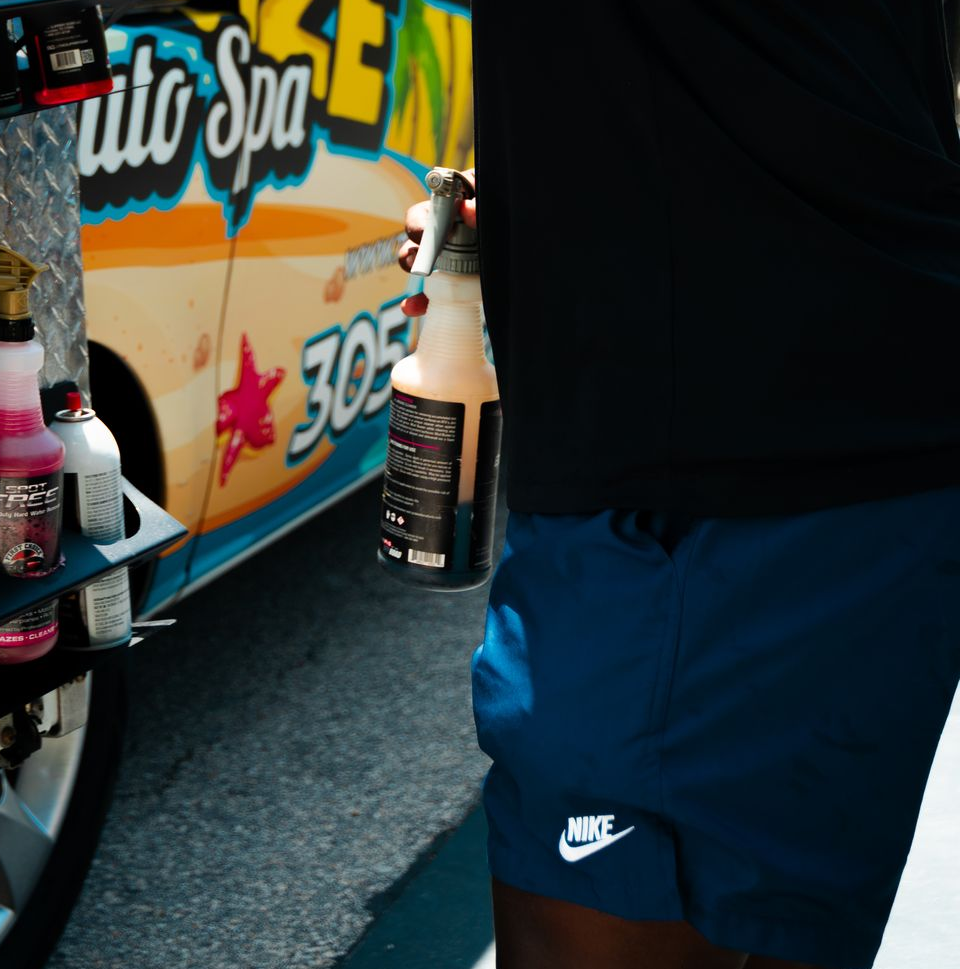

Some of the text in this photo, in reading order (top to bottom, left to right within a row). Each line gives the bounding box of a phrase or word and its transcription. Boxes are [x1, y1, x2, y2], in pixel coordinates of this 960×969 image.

[78, 25, 312, 194] uto Spa
[289, 300, 412, 457] 305
[6, 482, 47, 494] SPOT
[4, 544, 24, 562] FIRST
[567, 814, 615, 843] NIKE
